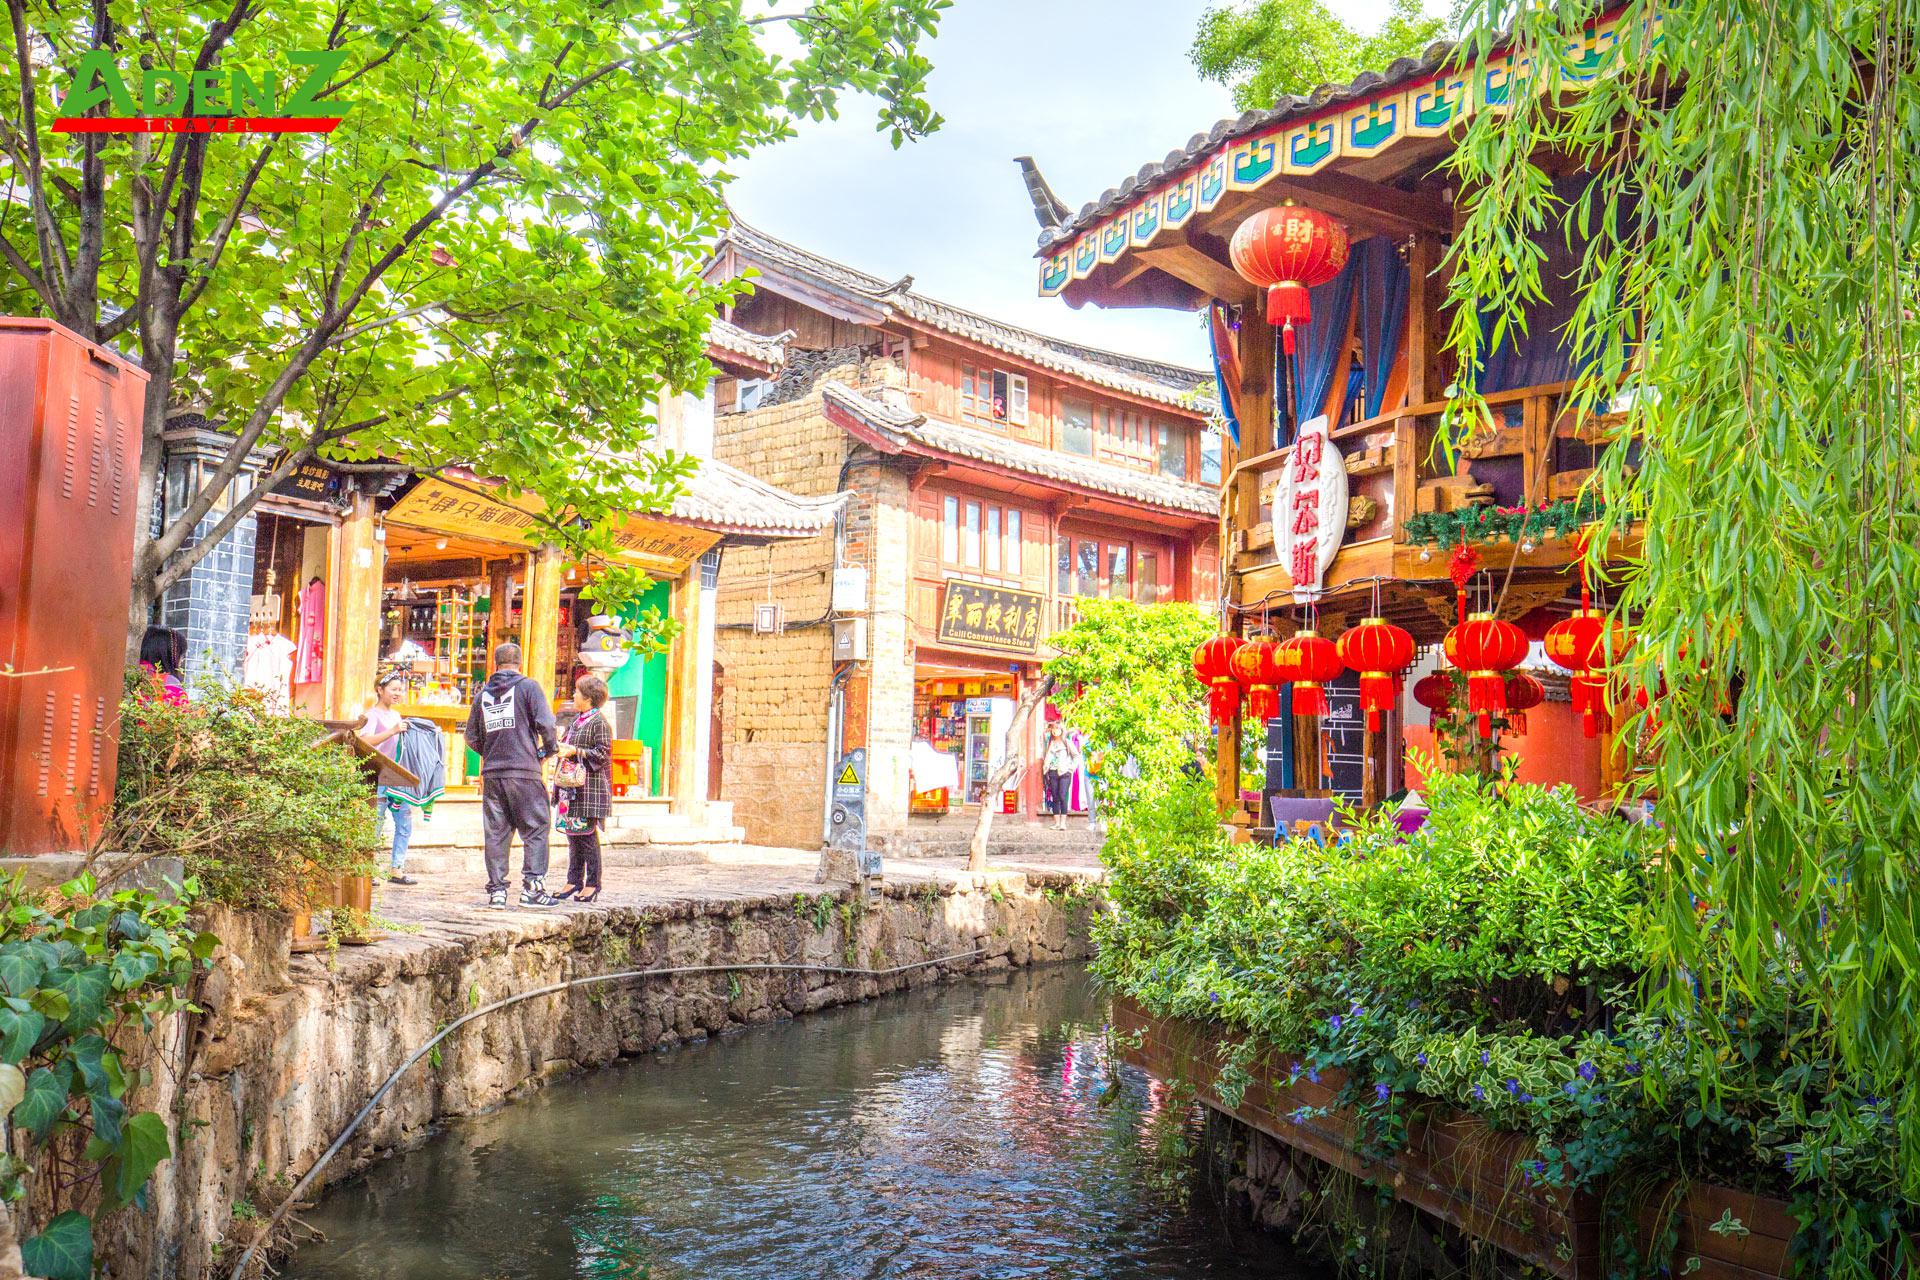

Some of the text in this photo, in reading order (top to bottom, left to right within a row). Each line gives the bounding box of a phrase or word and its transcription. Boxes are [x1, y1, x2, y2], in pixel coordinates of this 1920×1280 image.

[946, 593, 1038, 639] 翠丽便利店
